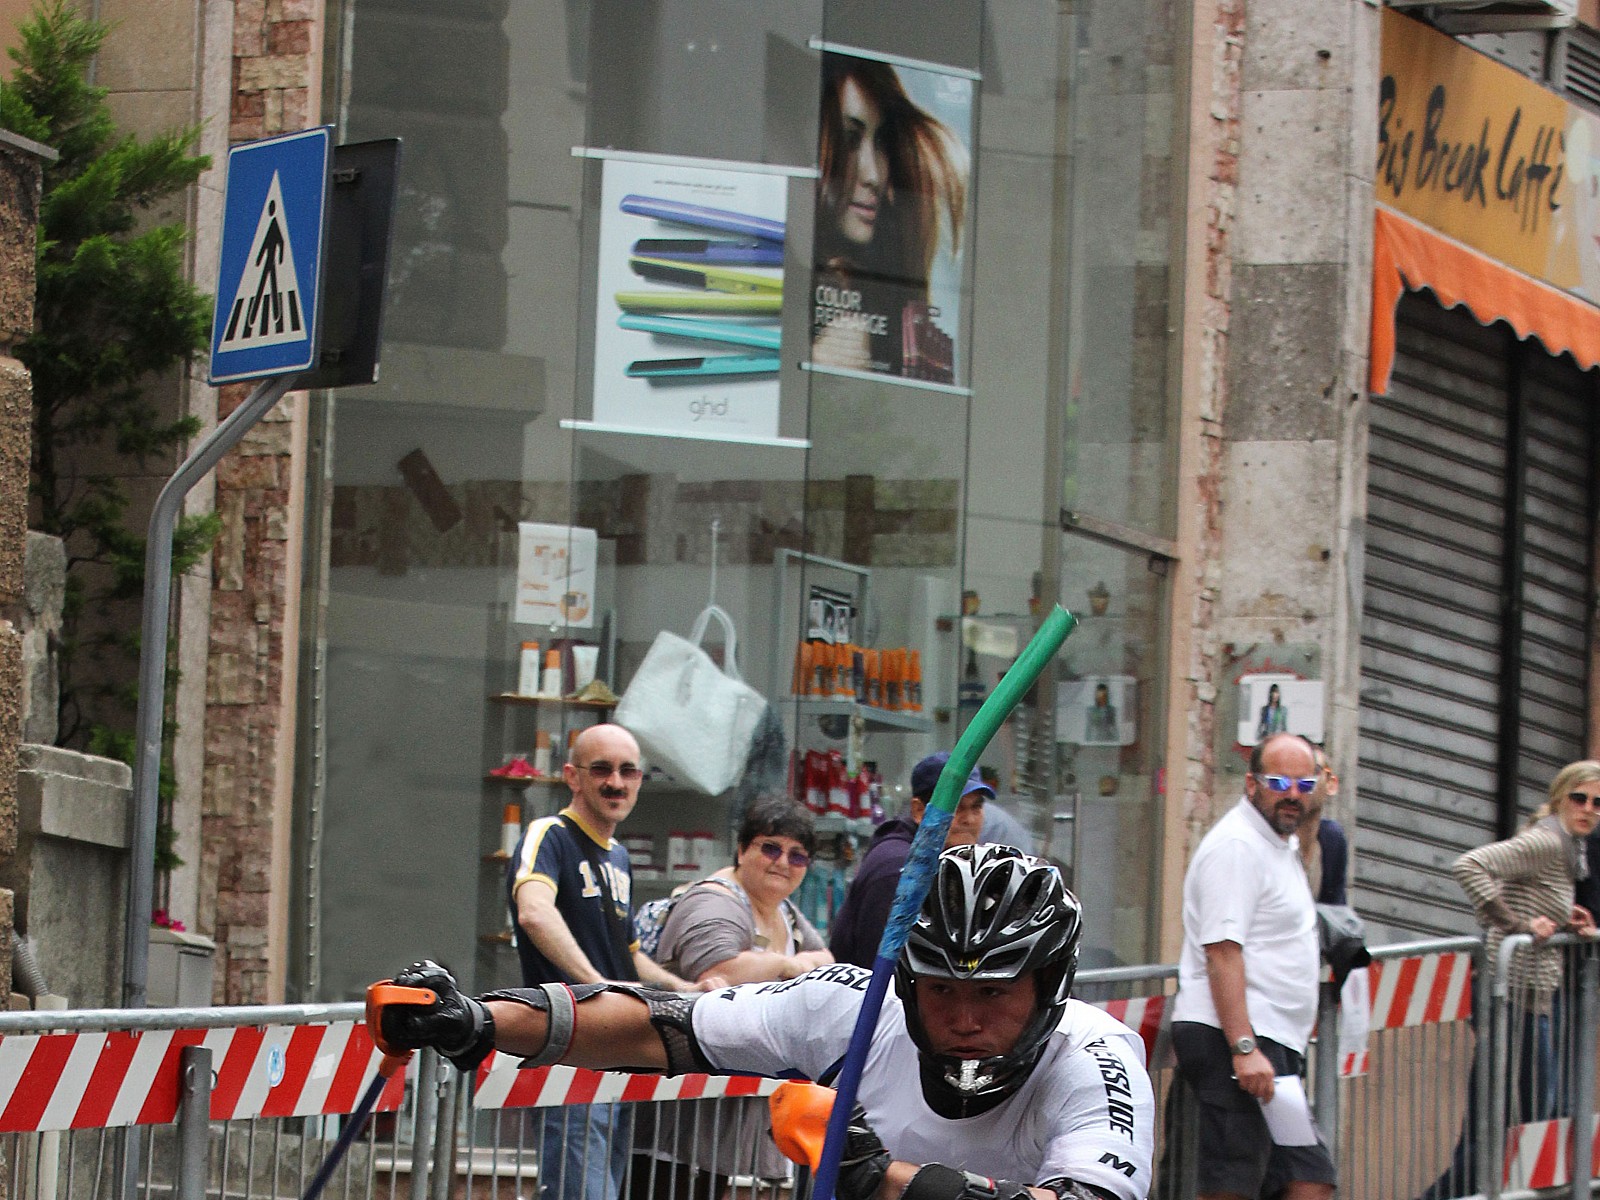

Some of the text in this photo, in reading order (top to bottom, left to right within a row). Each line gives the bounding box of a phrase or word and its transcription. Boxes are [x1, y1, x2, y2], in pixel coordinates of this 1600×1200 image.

[1416, 84, 1490, 209] Break
[816, 285, 862, 311] COLOR
[688, 394, 728, 422] ghd
